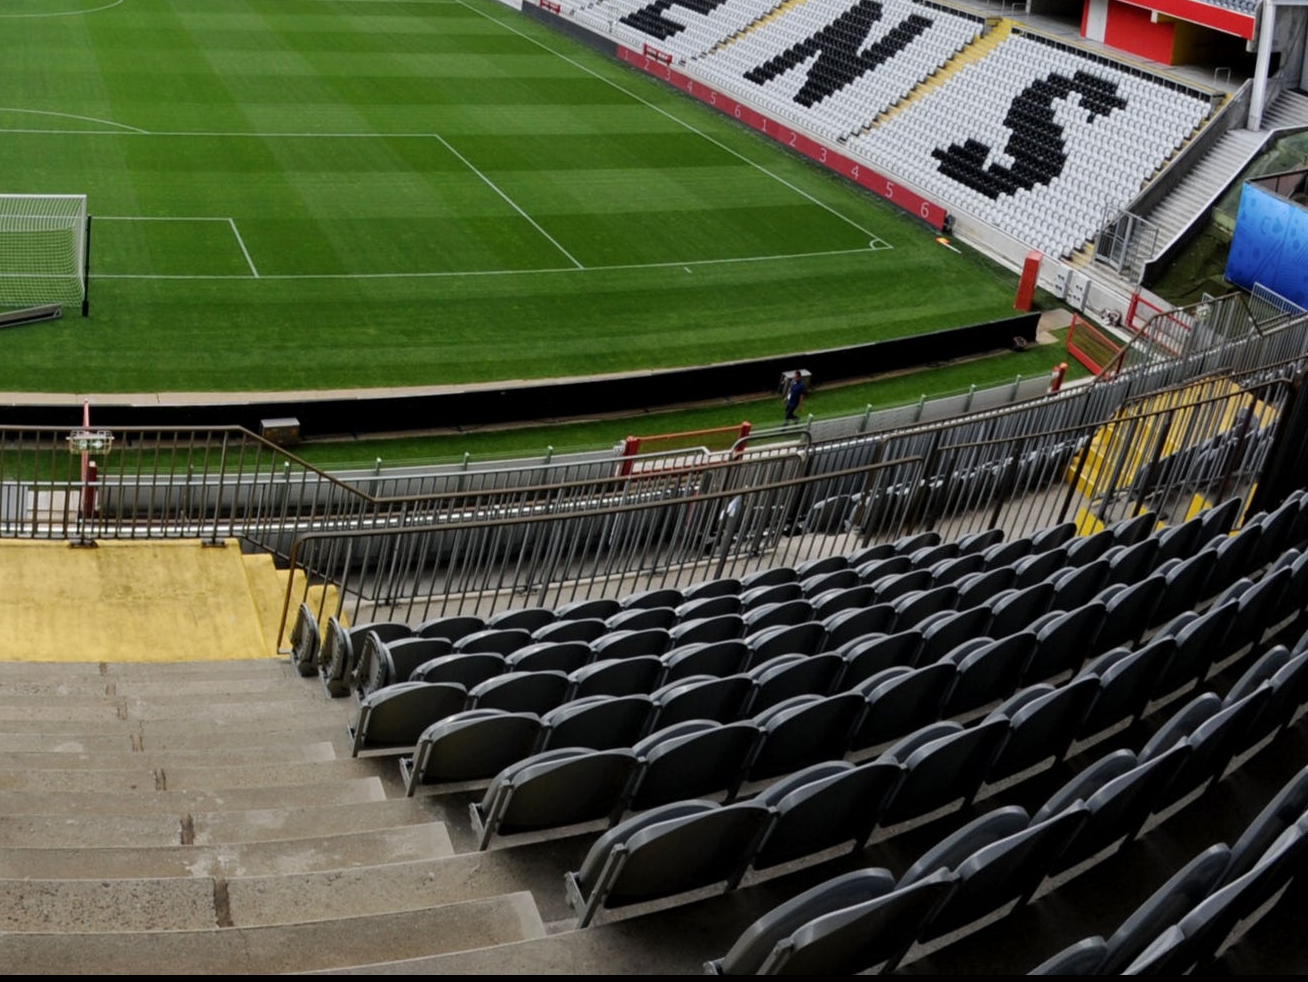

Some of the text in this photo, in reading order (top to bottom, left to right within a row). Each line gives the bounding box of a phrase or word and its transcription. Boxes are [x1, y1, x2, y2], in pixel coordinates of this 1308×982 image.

[624, 50, 929, 218] 1 2 3 4 5 6 1 2 3 4 5 6
